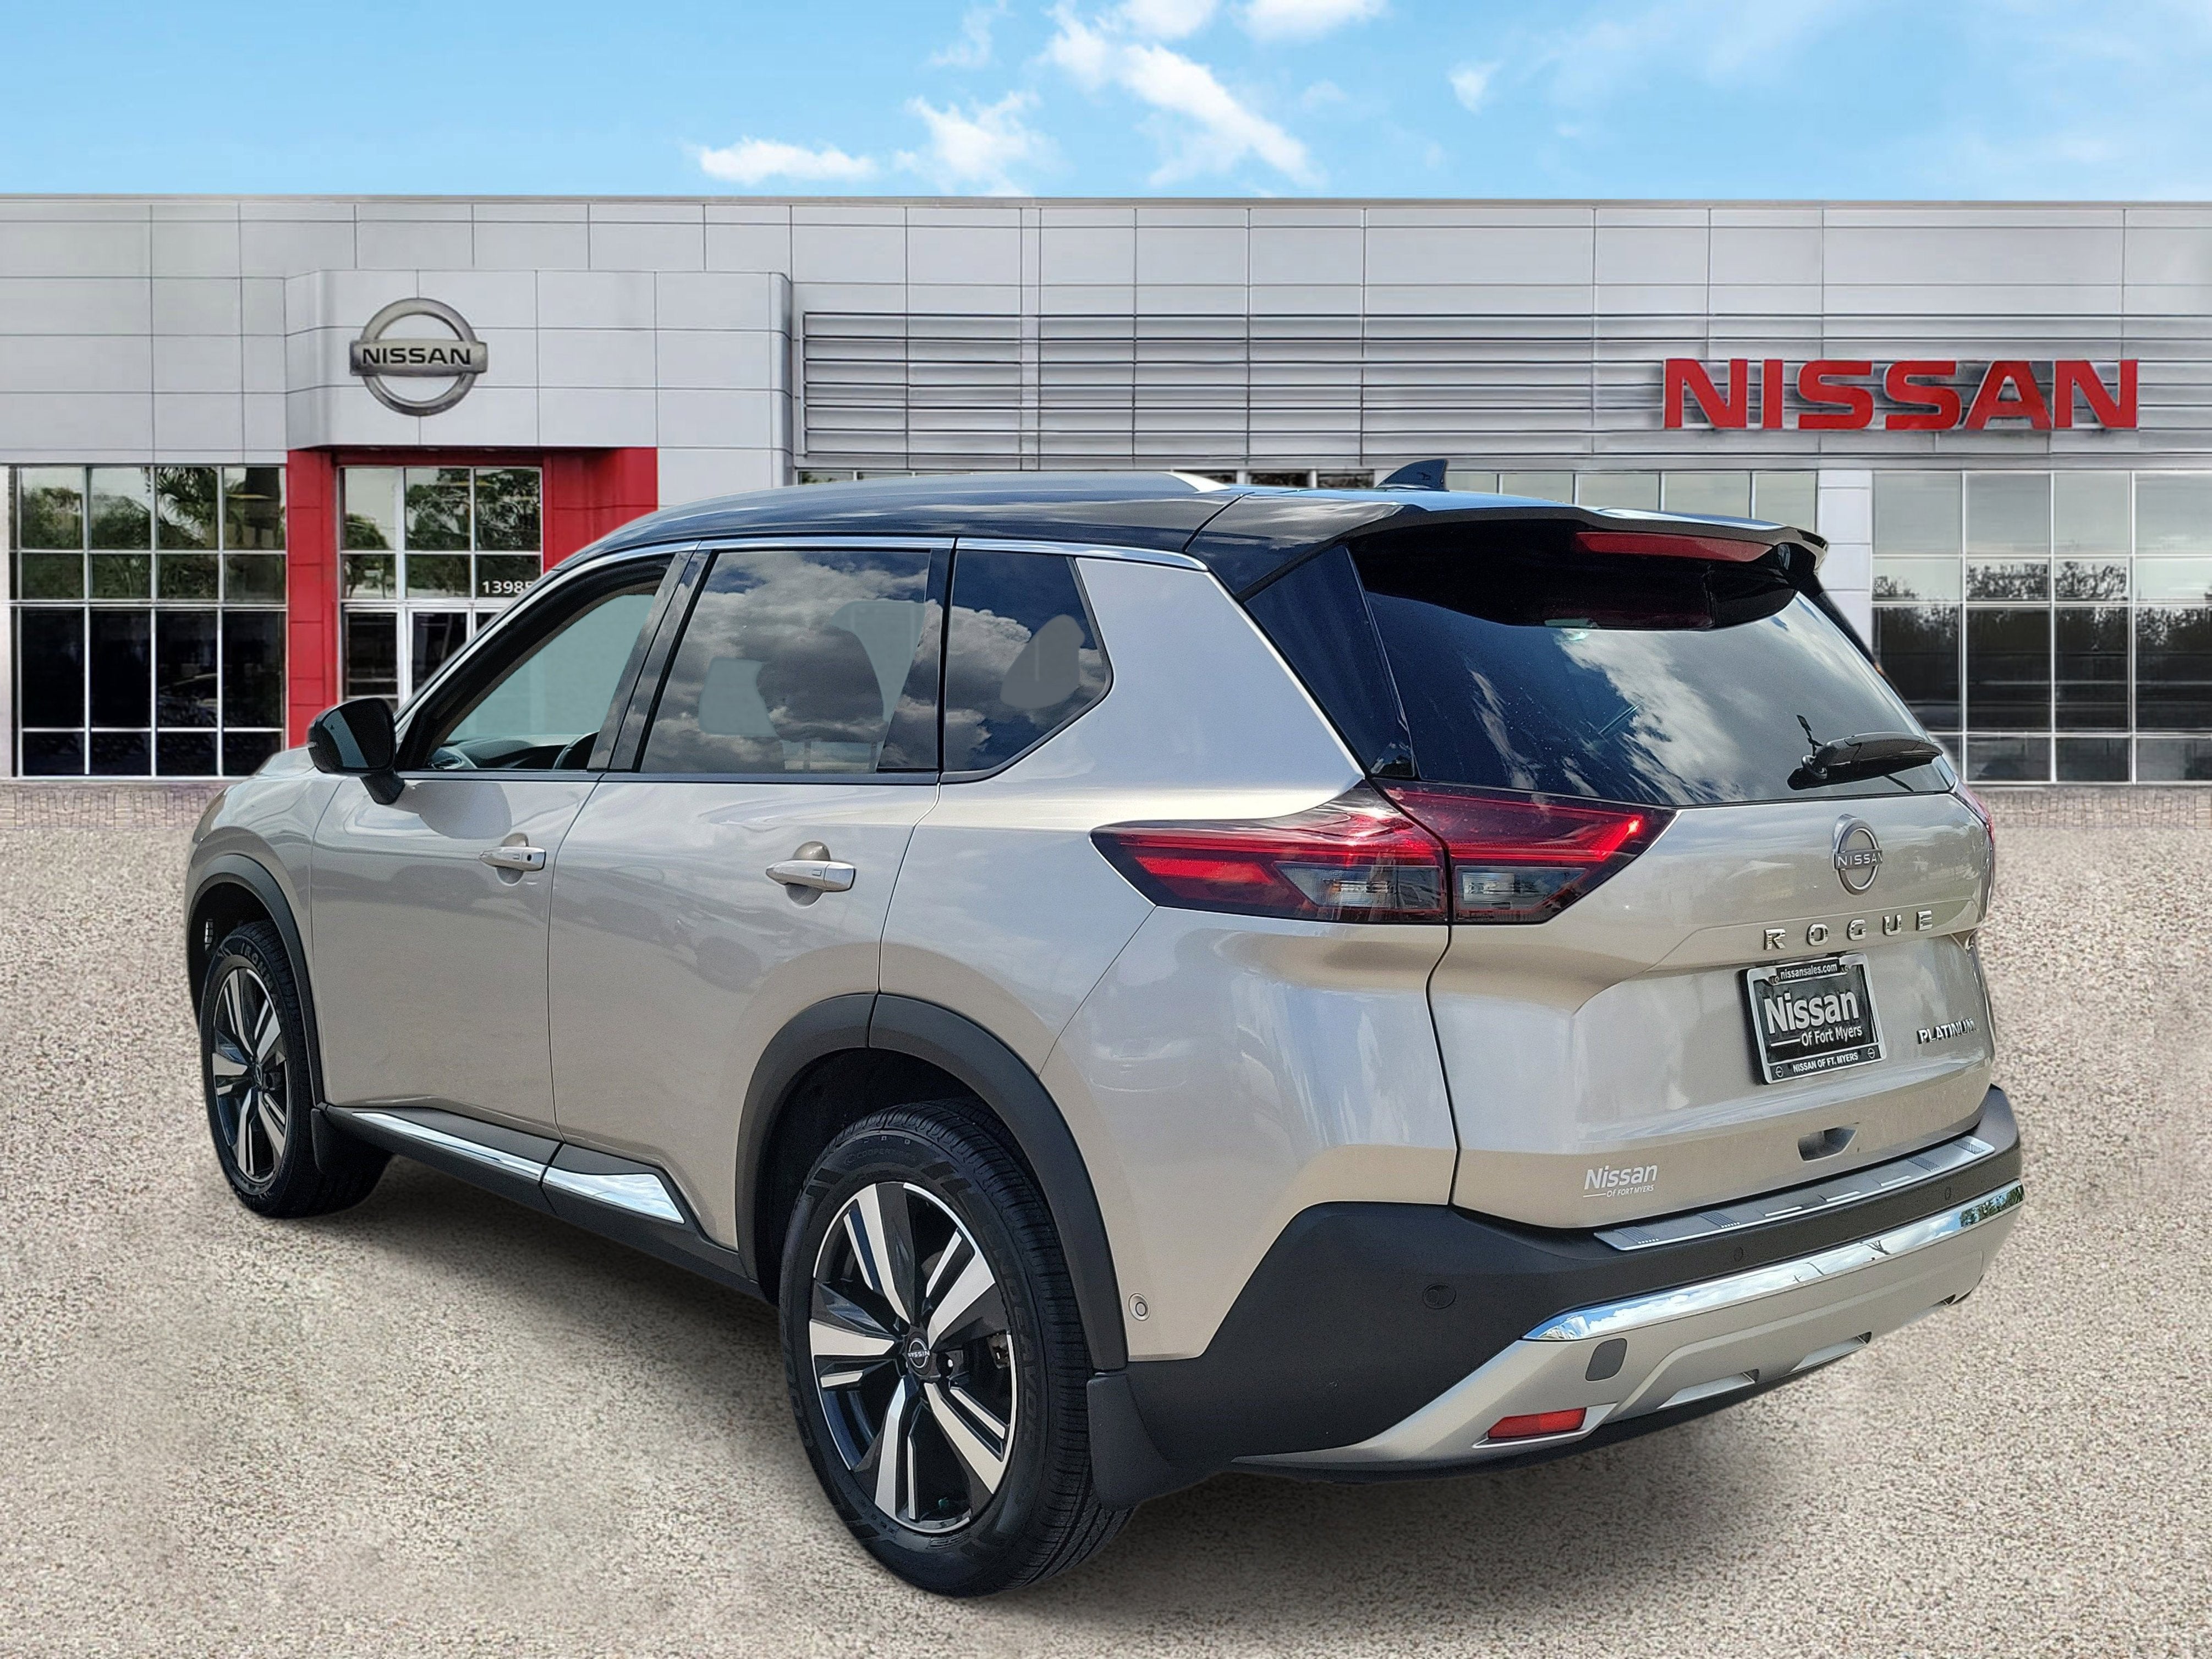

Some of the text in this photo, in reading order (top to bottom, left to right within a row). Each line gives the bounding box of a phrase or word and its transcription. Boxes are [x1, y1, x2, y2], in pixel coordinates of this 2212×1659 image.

[363, 348, 471, 365] NISSAN
[1664, 358, 2138, 430] NISSAN
[1764, 910, 1933, 951] ROGUE
[1780, 963, 1838, 980] nissansales.com
[1764, 991, 1859, 1034] Nissan
[1801, 1025, 1863, 1046] Of Fort Myers
[1917, 1018, 1976, 1044] PLATINUM
[1793, 1052, 1858, 1073] NISSAN OF FT. MYERS
[1584, 1165, 1657, 1190] Nissan
[1617, 1187, 1634, 1196] FORT
[1634, 1184, 1654, 1194] MYERS
